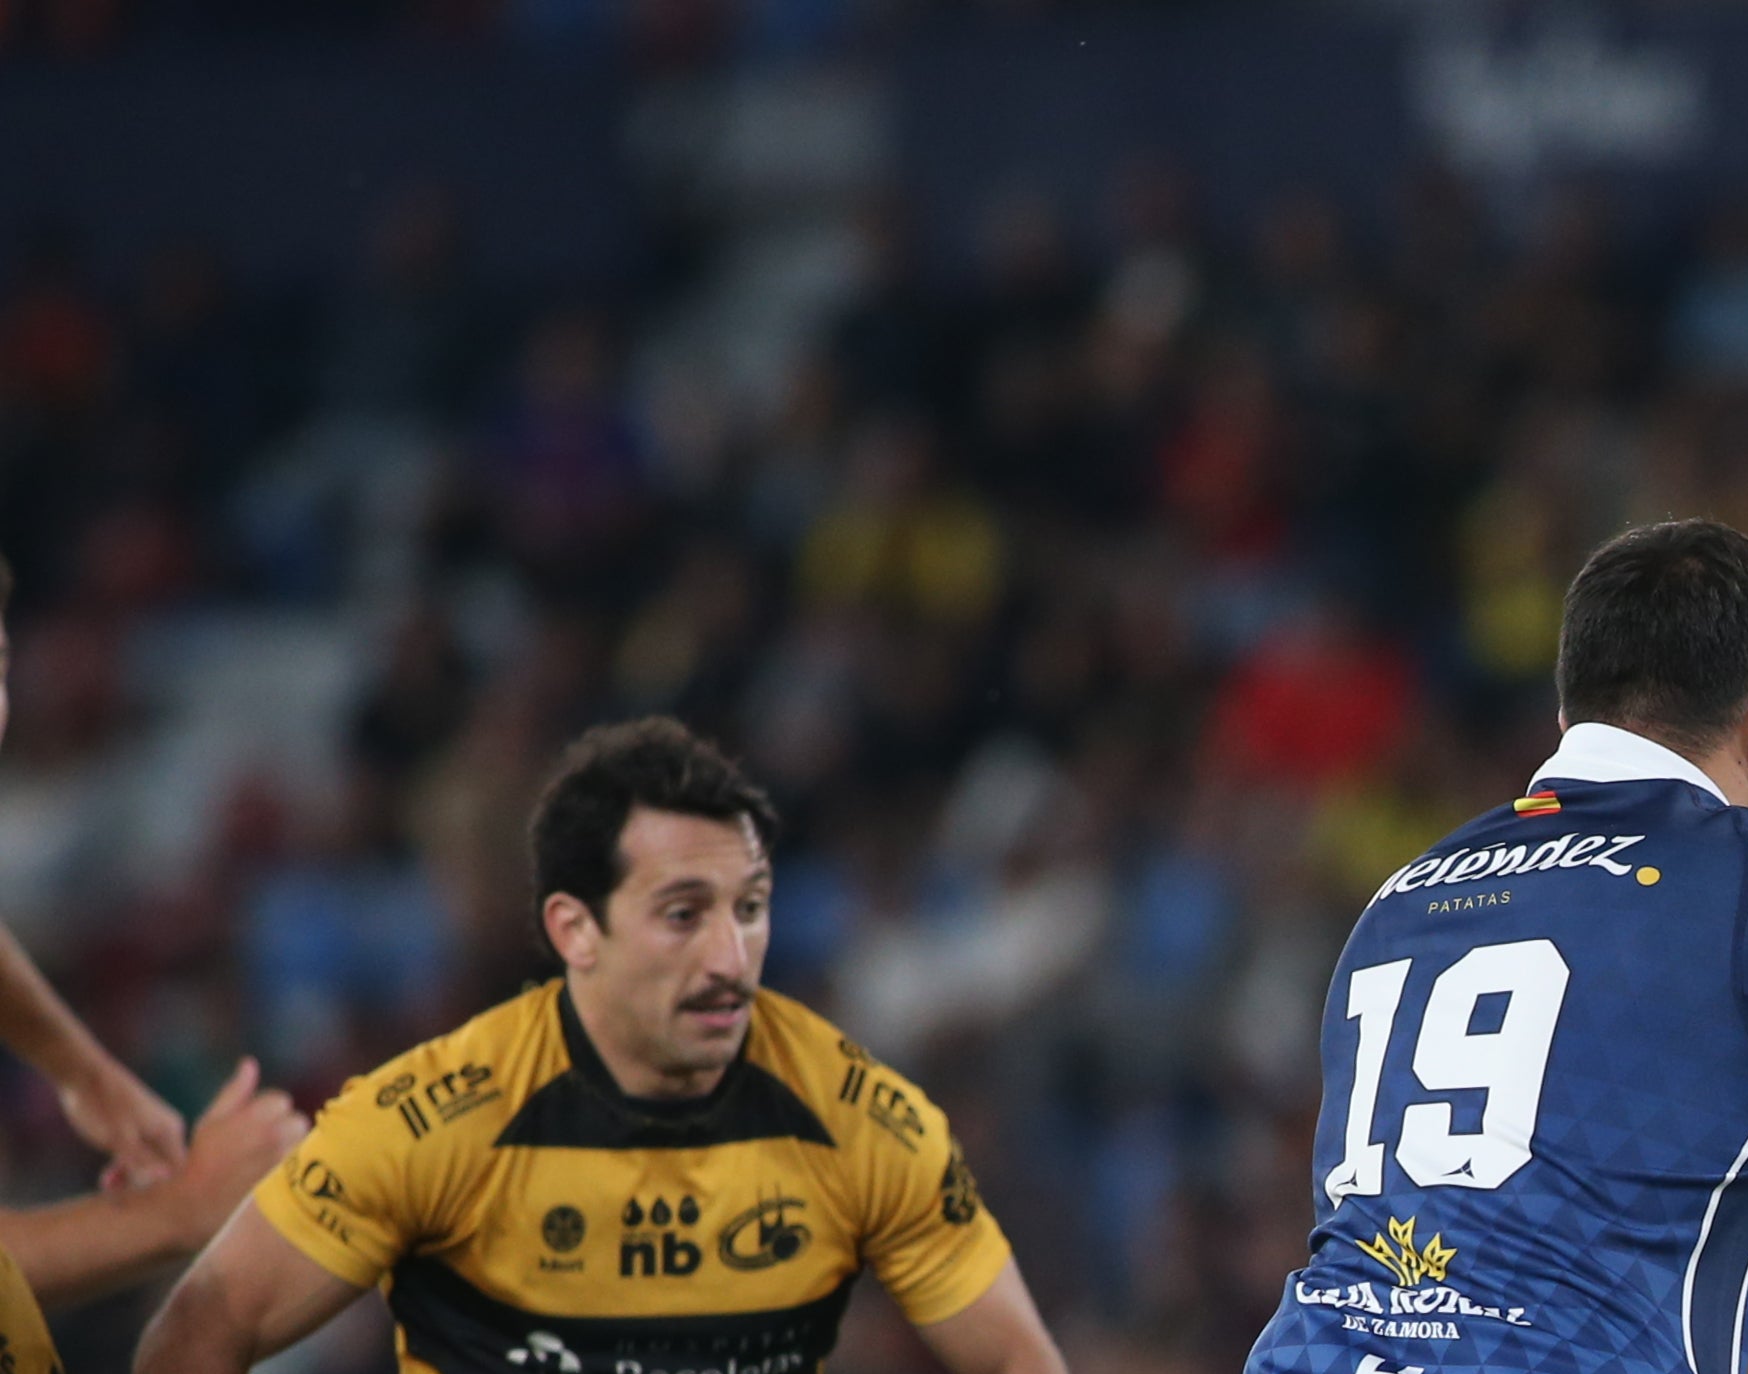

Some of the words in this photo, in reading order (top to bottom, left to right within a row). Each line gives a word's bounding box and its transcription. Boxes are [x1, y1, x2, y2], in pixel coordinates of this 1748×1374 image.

[1428, 890, 1511, 914] PATATAS
[1325, 937, 1571, 1211] 19
[619, 1232, 703, 1277] nb
[1370, 1315, 1461, 1341] ZAMORA
